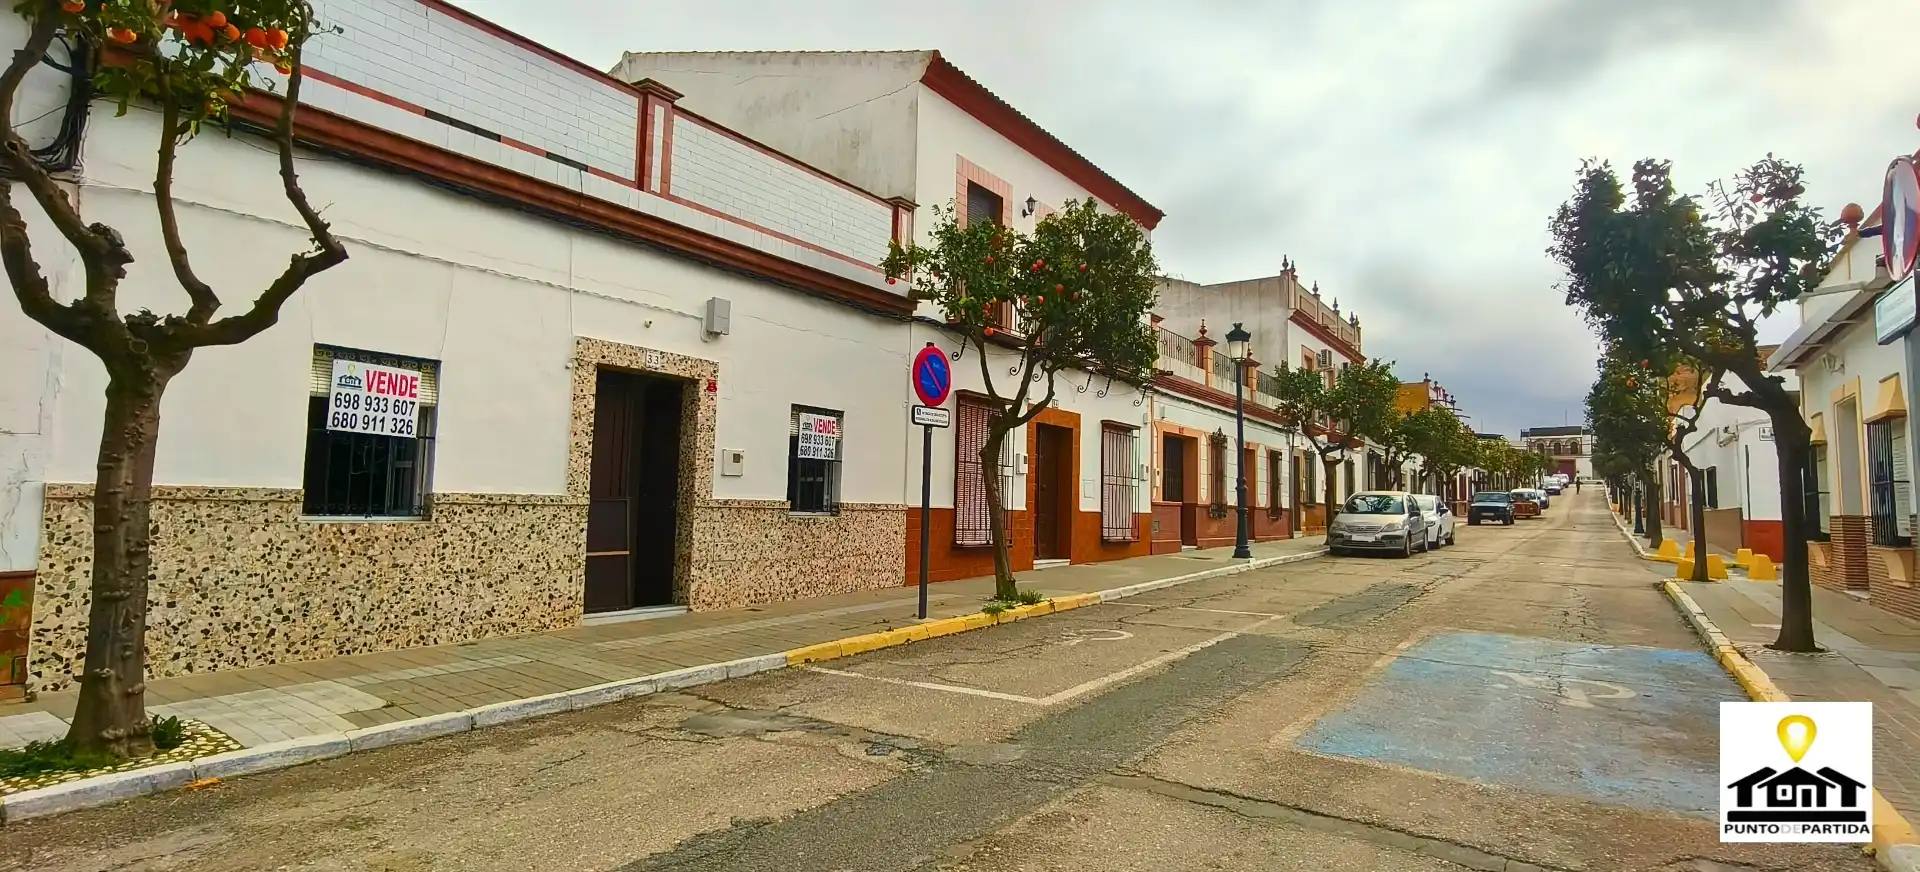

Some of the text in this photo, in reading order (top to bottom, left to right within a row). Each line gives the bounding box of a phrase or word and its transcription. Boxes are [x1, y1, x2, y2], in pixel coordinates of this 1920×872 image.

[648, 355, 659, 364] 33
[366, 370, 418, 398] VENDE
[334, 392, 416, 416] 698 933 607
[332, 411, 413, 435] 680 911 326
[814, 418, 835, 435] VENDE
[814, 434, 823, 445] 933
[812, 447, 823, 458] 911
